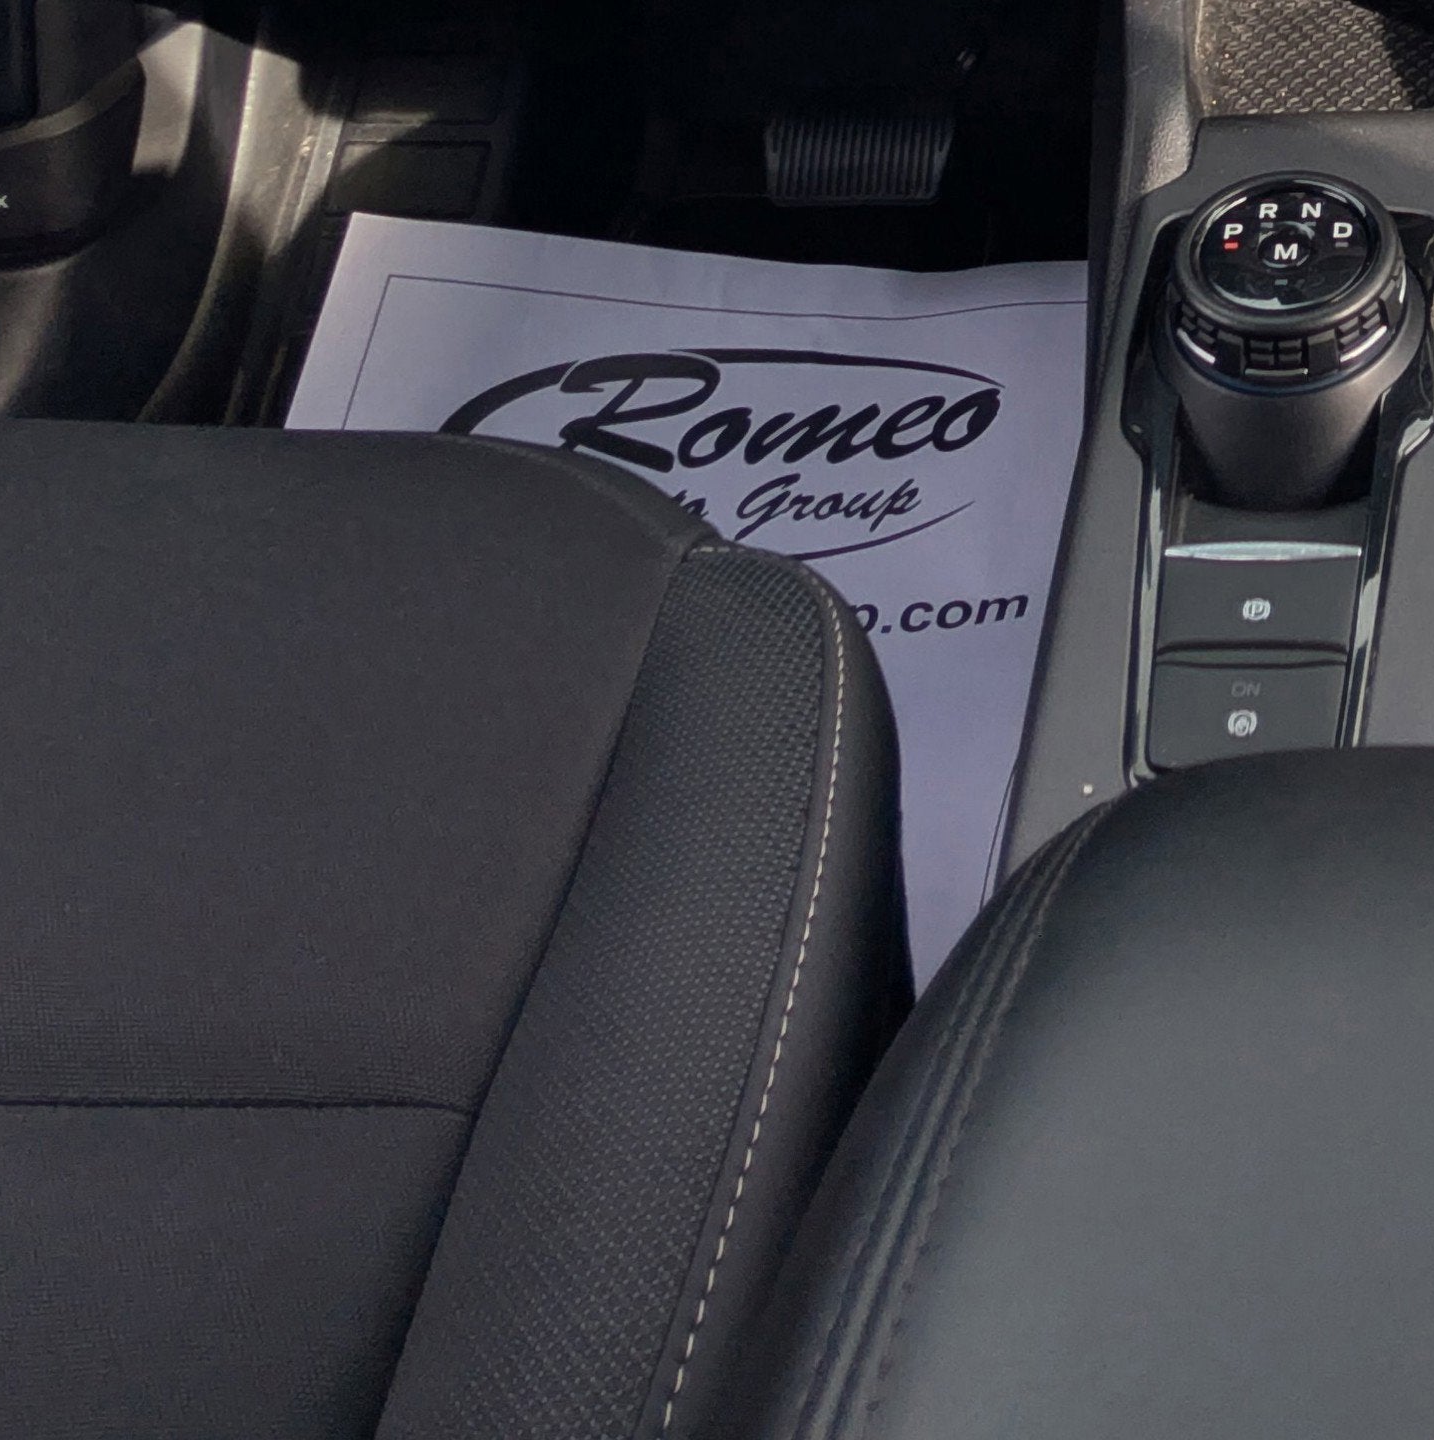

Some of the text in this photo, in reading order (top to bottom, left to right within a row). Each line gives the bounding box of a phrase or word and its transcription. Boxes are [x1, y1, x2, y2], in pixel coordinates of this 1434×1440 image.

[1258, 202, 1279, 220] R
[1300, 201, 1322, 219] N
[1223, 222, 1244, 240] P
[1332, 221, 1354, 239] D
[1273, 242, 1299, 261] M
[558, 352, 1003, 473] Romeo
[734, 472, 924, 542] Group
[850, 591, 1030, 636] p.com
[1230, 680, 1262, 698] ON
